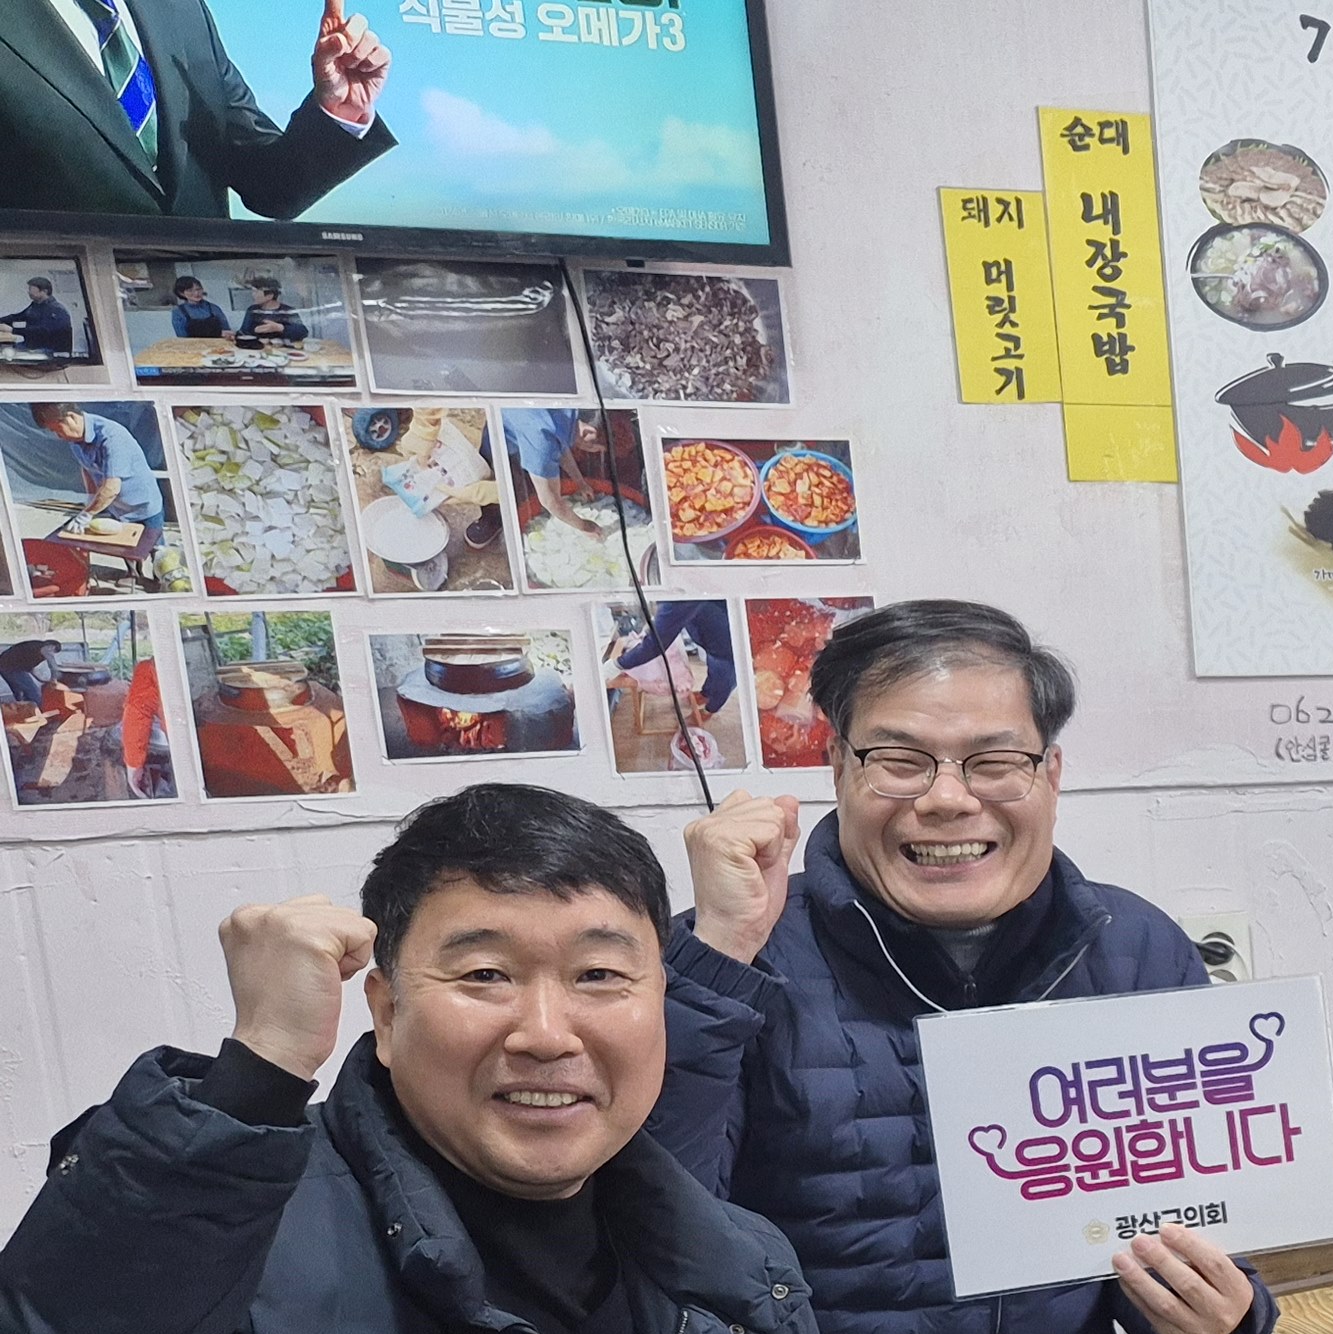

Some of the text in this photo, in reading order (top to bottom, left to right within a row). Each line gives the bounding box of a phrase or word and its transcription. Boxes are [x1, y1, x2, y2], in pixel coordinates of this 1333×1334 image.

[399, 0, 686, 52] 식물성 오메가3
[1060, 116, 1130, 155] 순대
[960, 195, 1025, 229] 돼지
[981, 258, 1025, 400] 머릿고기
[1080, 190, 1136, 376] 내장국밥
[1029, 1036, 1274, 1128] 여러분을
[1003, 1102, 1302, 1201] 응원합니다
